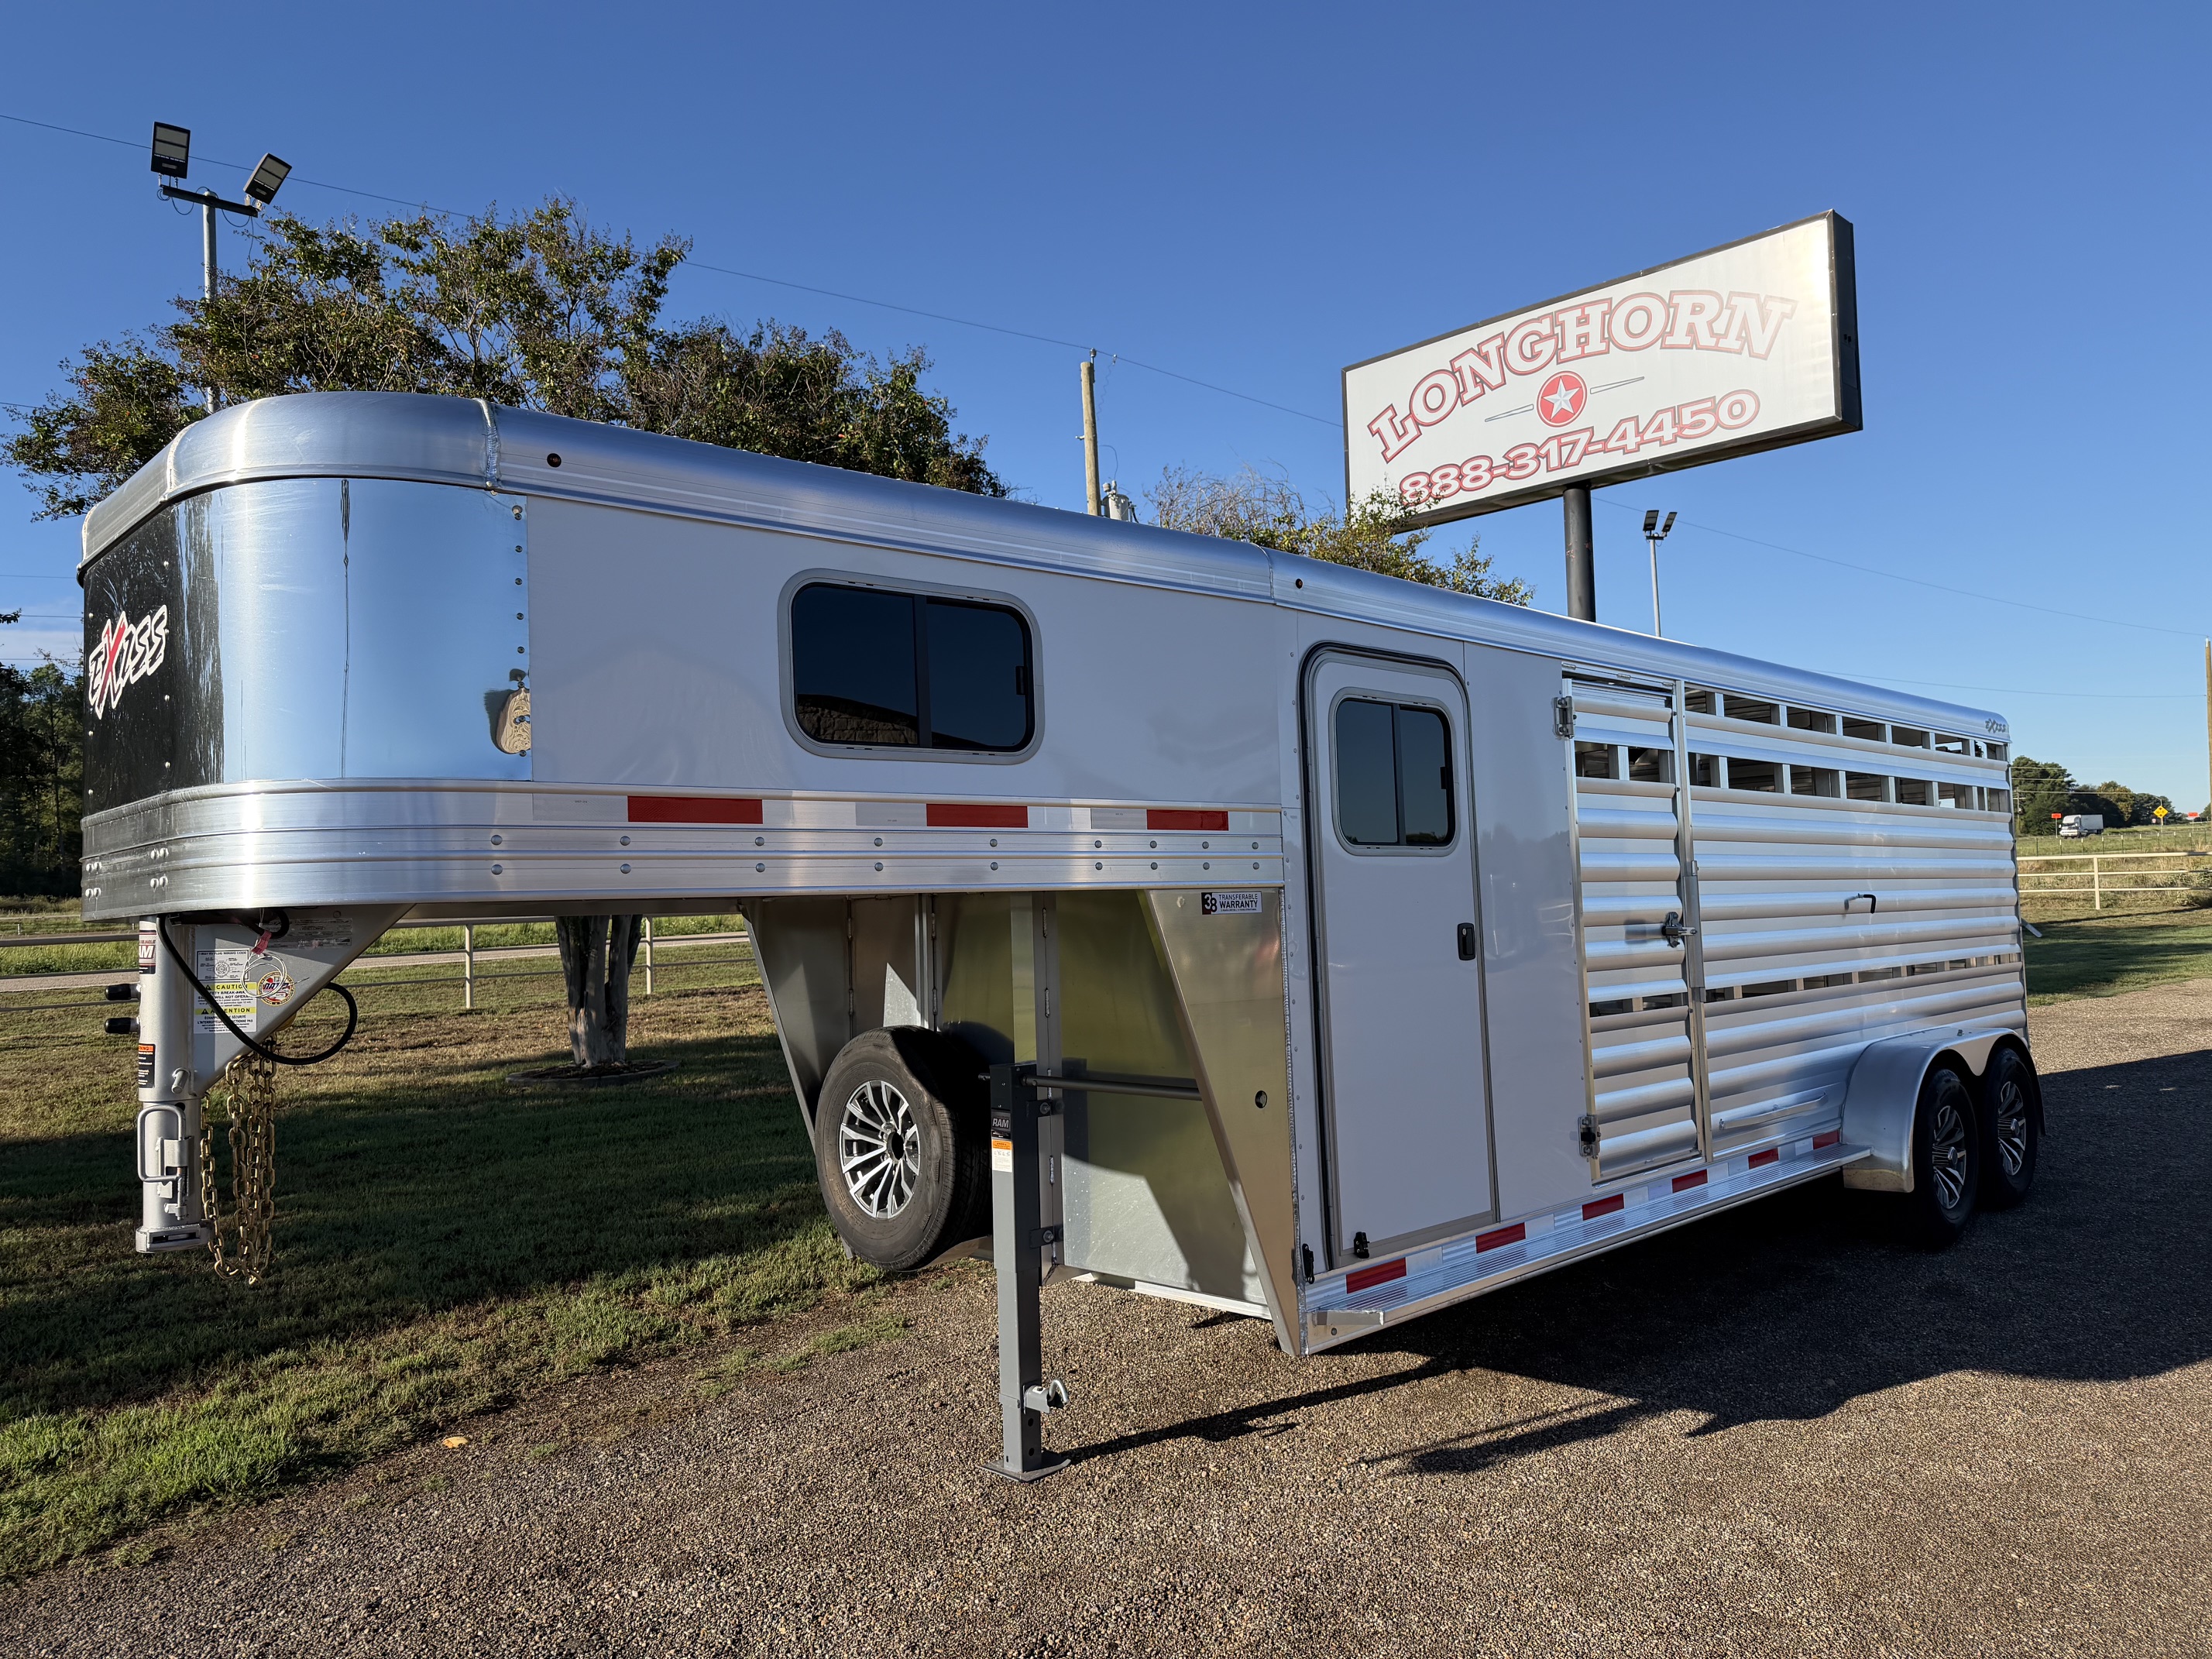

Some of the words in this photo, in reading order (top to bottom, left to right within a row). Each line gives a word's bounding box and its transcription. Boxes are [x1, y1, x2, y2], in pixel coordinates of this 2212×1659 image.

[1368, 290, 1798, 463] LONGHORN
[1400, 389, 1760, 507] 888-317-4450
[1219, 900, 1258, 908] WARRANTY
[992, 1118, 1010, 1128] RAM
